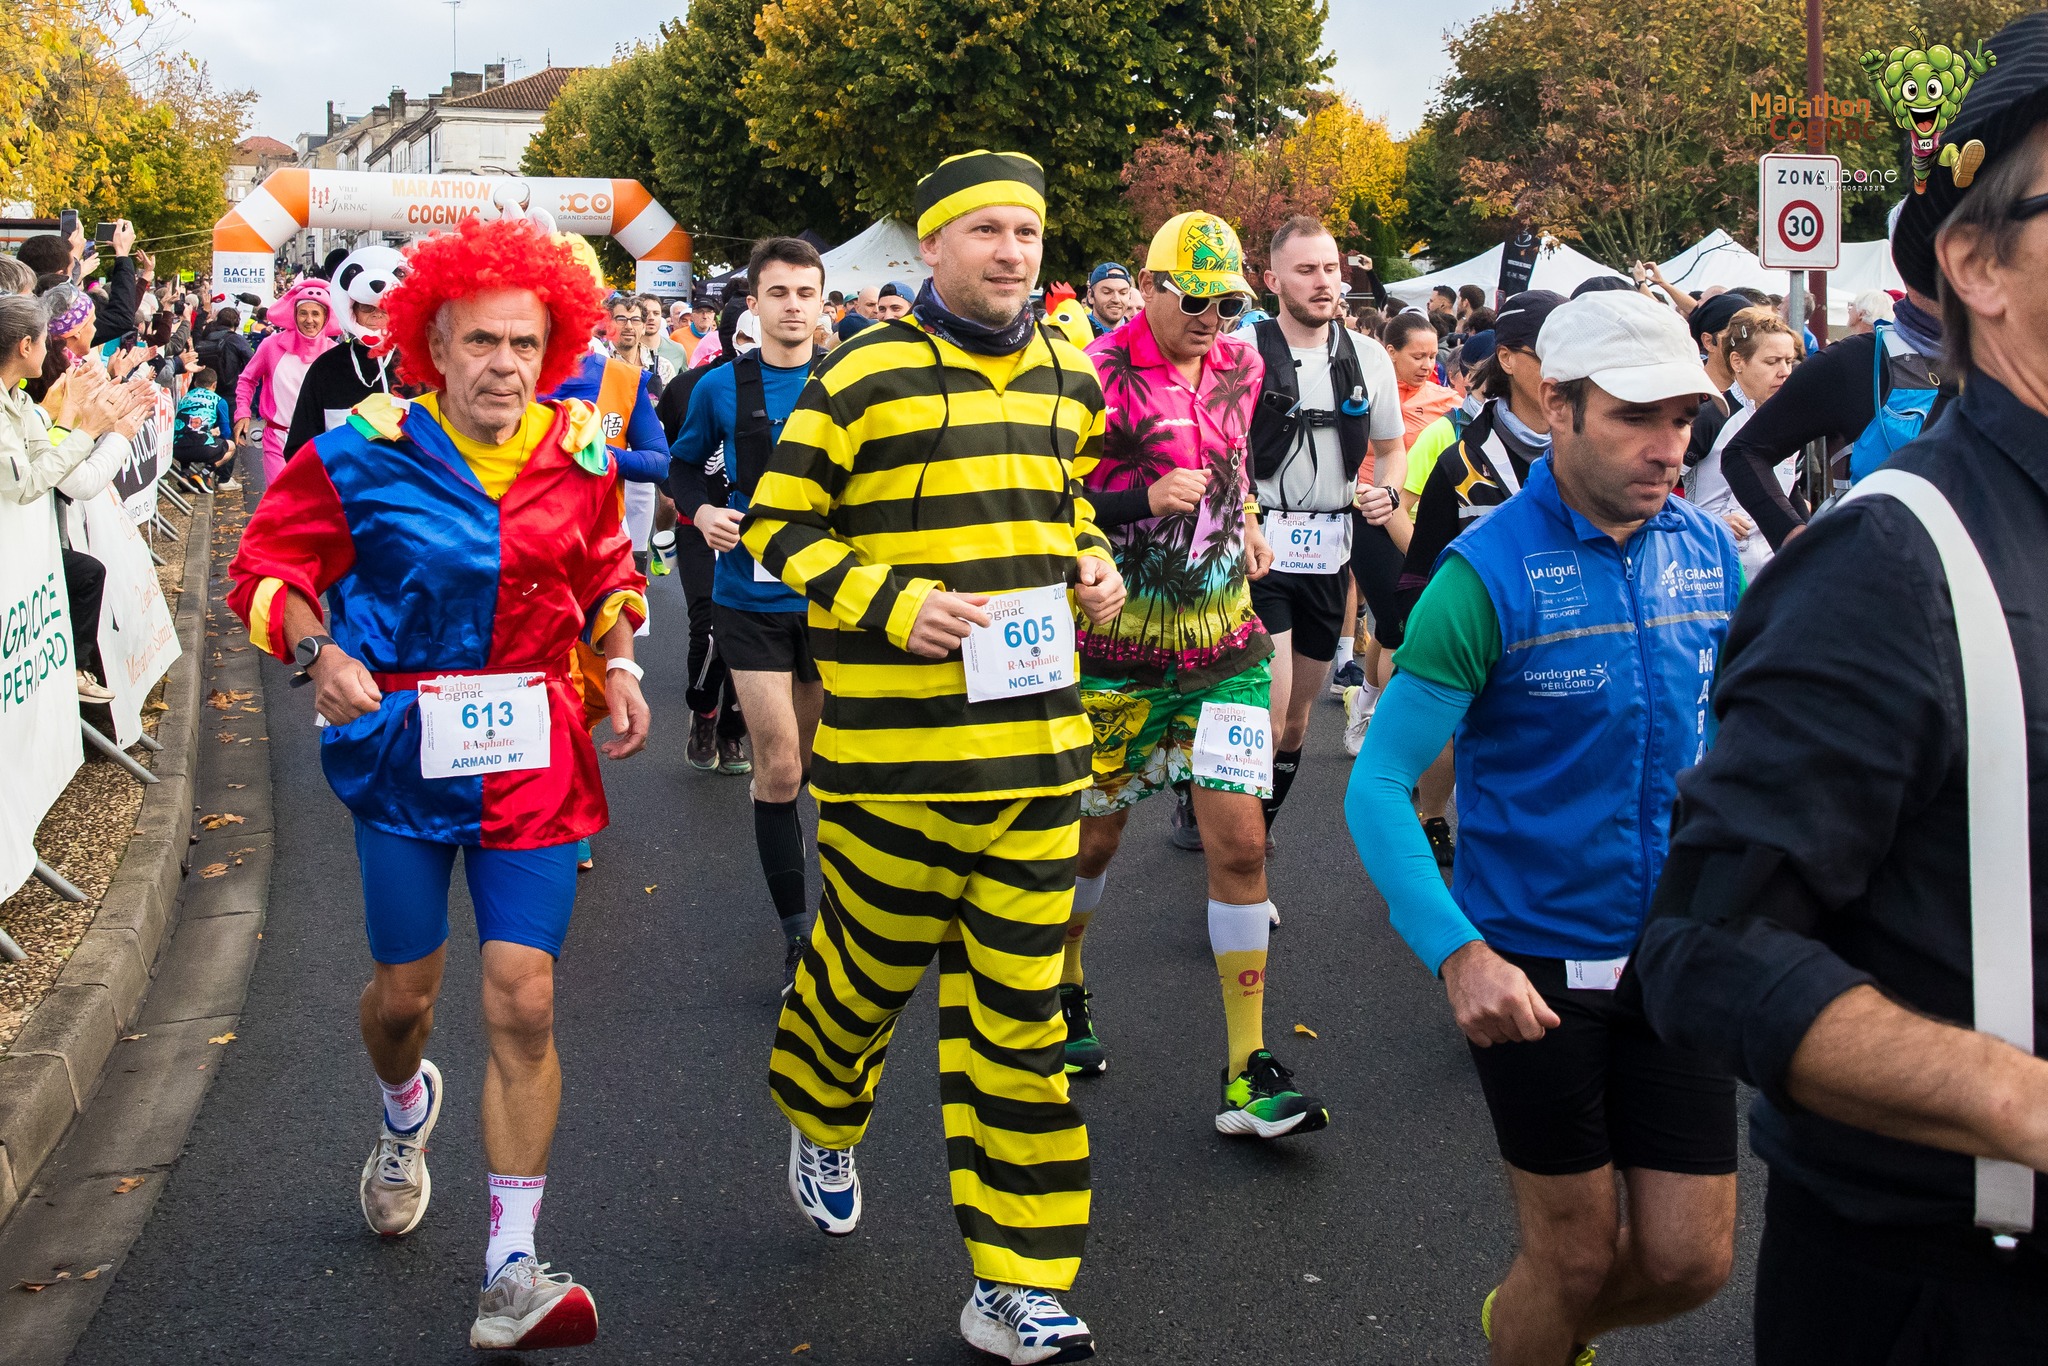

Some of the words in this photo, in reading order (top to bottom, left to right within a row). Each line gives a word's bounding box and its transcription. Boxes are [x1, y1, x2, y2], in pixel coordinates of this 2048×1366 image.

[1777, 170, 1826, 186] ZONE
[338, 185, 358, 193] VILLE
[392, 179, 492, 201] MARATHON
[324, 197, 368, 214] JARNAC
[391, 208, 405, 219] du
[1787, 215, 1815, 237] 30
[223, 267, 266, 277] BACHE
[1291, 528, 1321, 545] 671
[1281, 561, 1313, 569] FLORIAN
[1531, 568, 1545, 579] LA
[1676, 569, 1683, 577] LE
[1684, 566, 1724, 580] GRAND
[986, 607, 1024, 621] ognac
[1004, 615, 1055, 648] 605
[1008, 654, 1059, 671] R-Asphalte
[1009, 674, 1044, 689] NOEL
[1049, 670, 1062, 682] M2
[1524, 669, 1587, 681] Dordogne
[1540, 679, 1595, 690] PÉRIGORD
[461, 701, 514, 729] 613
[463, 738, 515, 751] R-Asphalte
[1228, 725, 1264, 749] 606
[451, 754, 502, 769] ARMAND
[508, 753, 524, 763] M7
[1216, 764, 1255, 778] PATRICE
